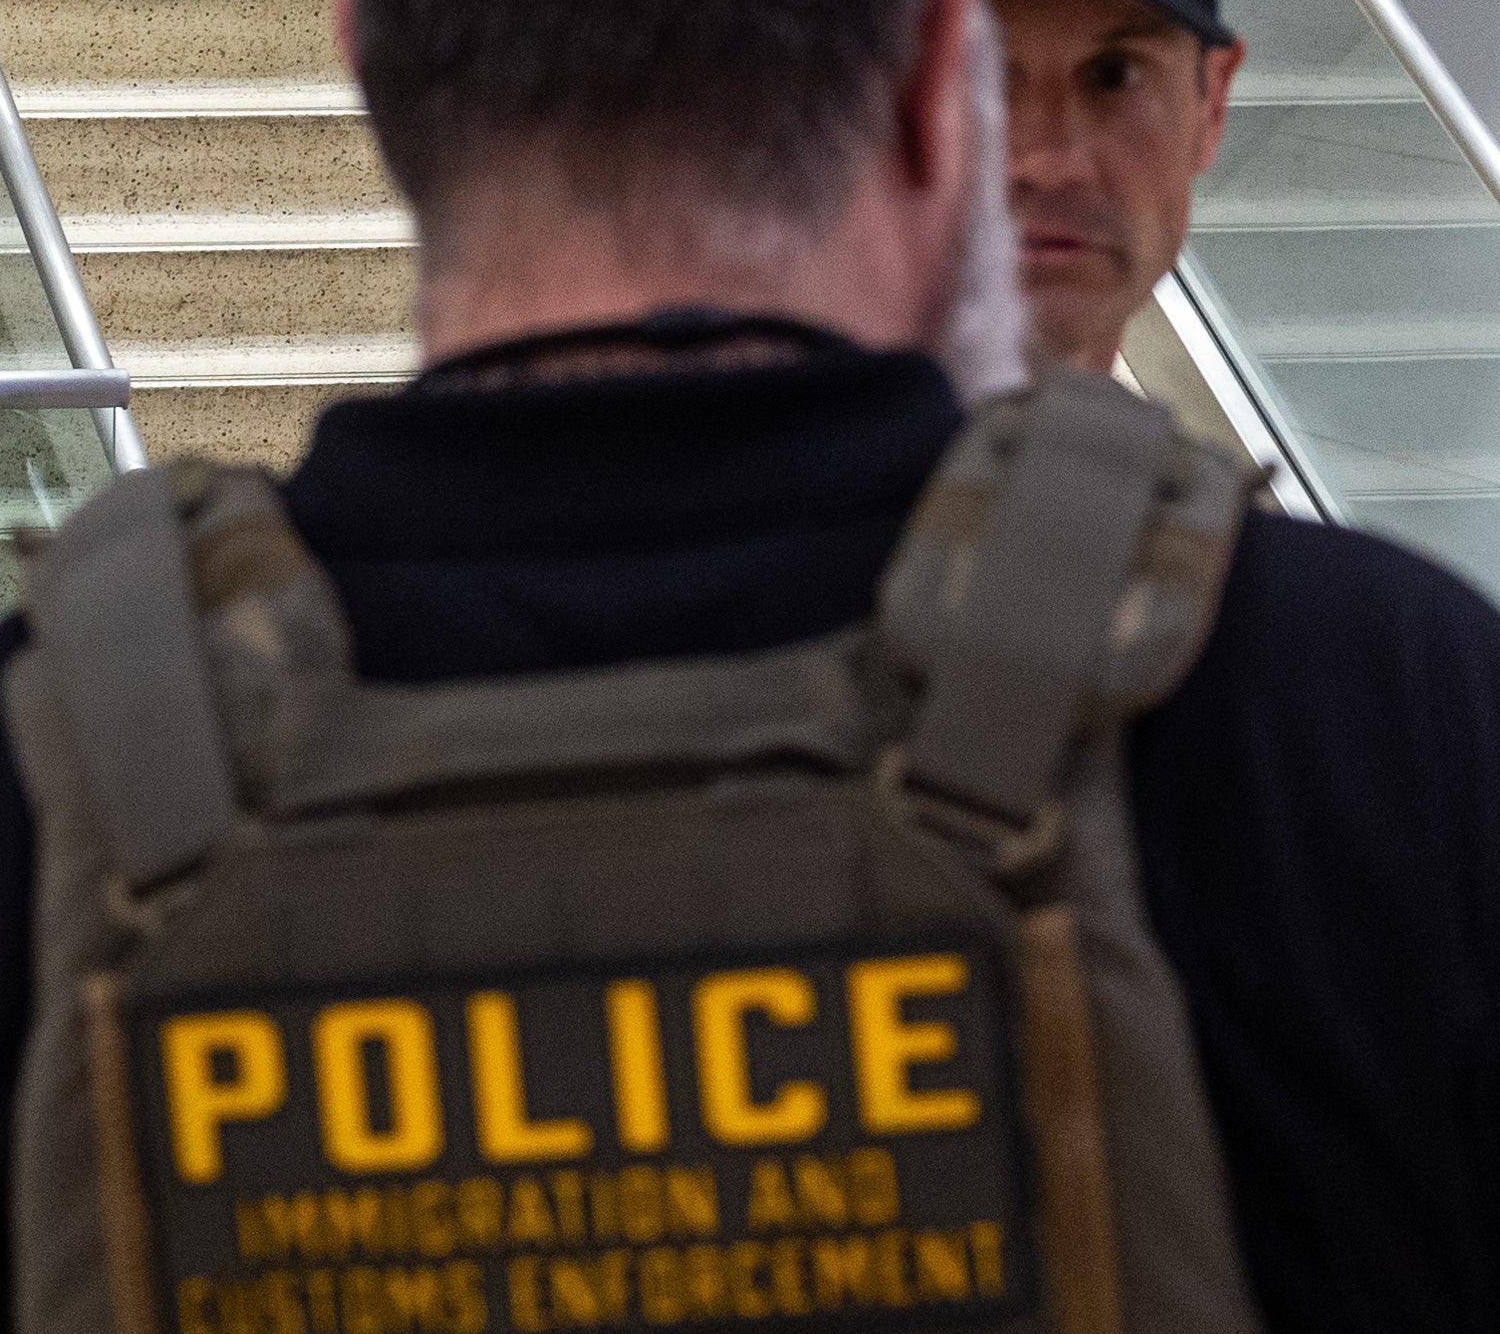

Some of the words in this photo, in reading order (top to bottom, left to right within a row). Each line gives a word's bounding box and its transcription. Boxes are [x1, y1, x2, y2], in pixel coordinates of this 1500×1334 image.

[158, 952, 984, 1185] POLICE
[235, 1163, 720, 1263] IMMIGRATION
[744, 1147, 901, 1233] AND
